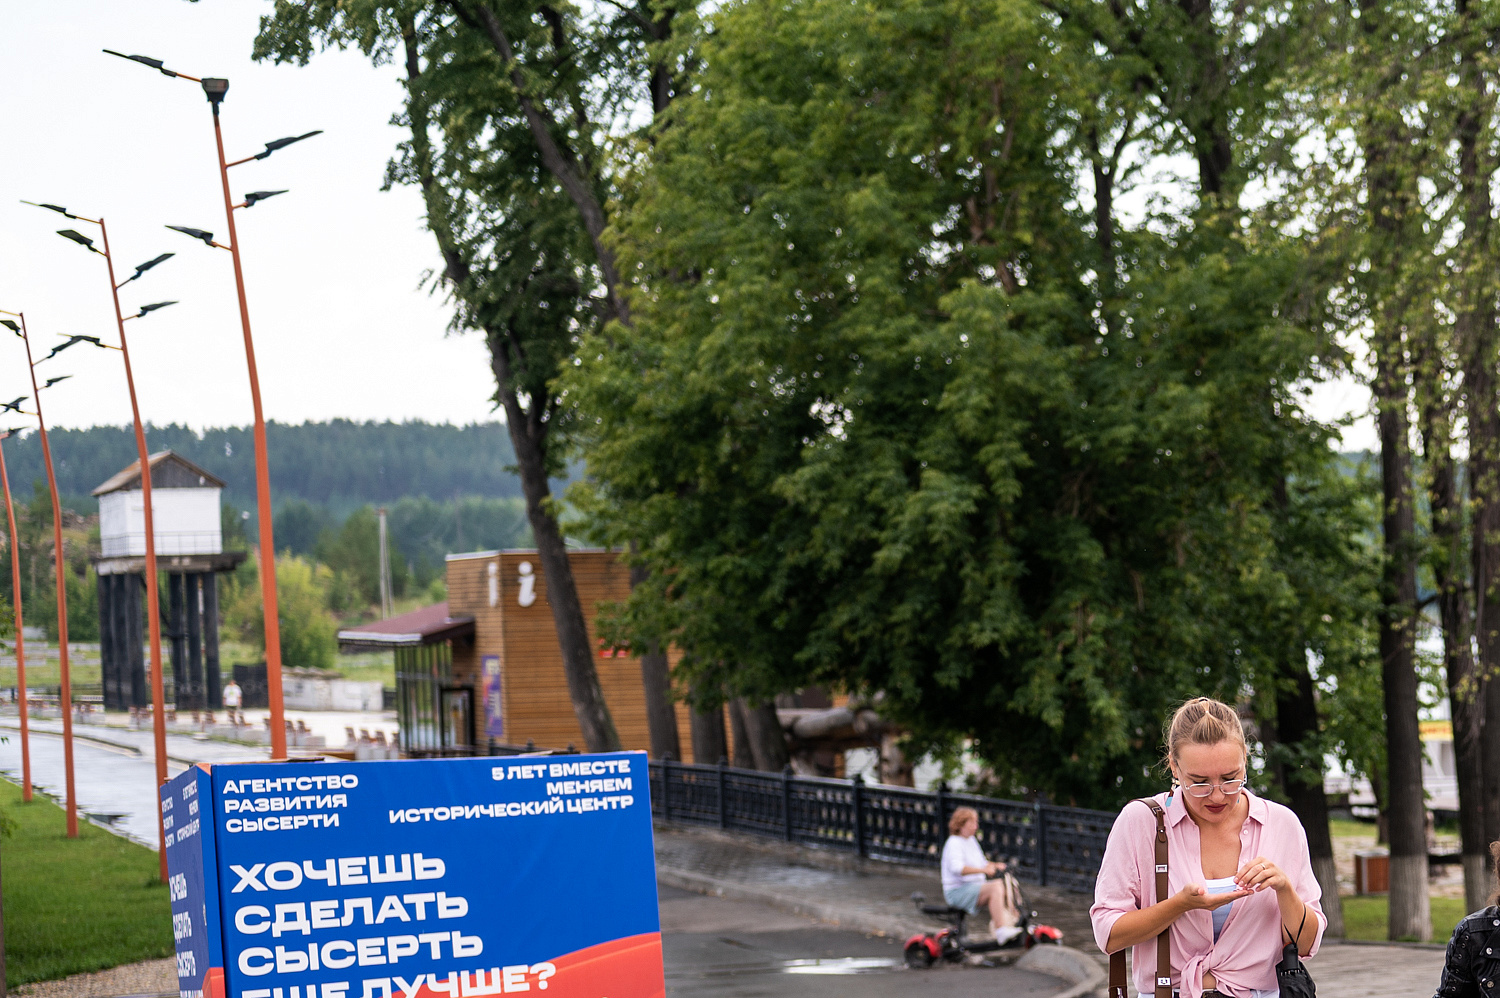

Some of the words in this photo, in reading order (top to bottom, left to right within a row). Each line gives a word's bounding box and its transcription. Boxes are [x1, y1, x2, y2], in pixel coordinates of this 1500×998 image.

[491, 767, 505, 781] 5
[506, 764, 548, 780] ЛЕТ
[549, 759, 631, 778] ВМЕСТЕ
[222, 774, 359, 794] АГЕНТСТВО
[546, 777, 632, 796] МЕНЯЕМ
[224, 793, 348, 813] РАЗВИТИЯ
[389, 796, 565, 824] ИСТОРИЧЕСКИЙ
[566, 795, 634, 815] ЦЕНТР
[225, 813, 340, 833] СЫСЕРТИ
[229, 852, 446, 893] ХОЧЕШЬ
[234, 891, 469, 937] СДЕЛАТЬ
[238, 930, 483, 976] СЫСЕРТЬ
